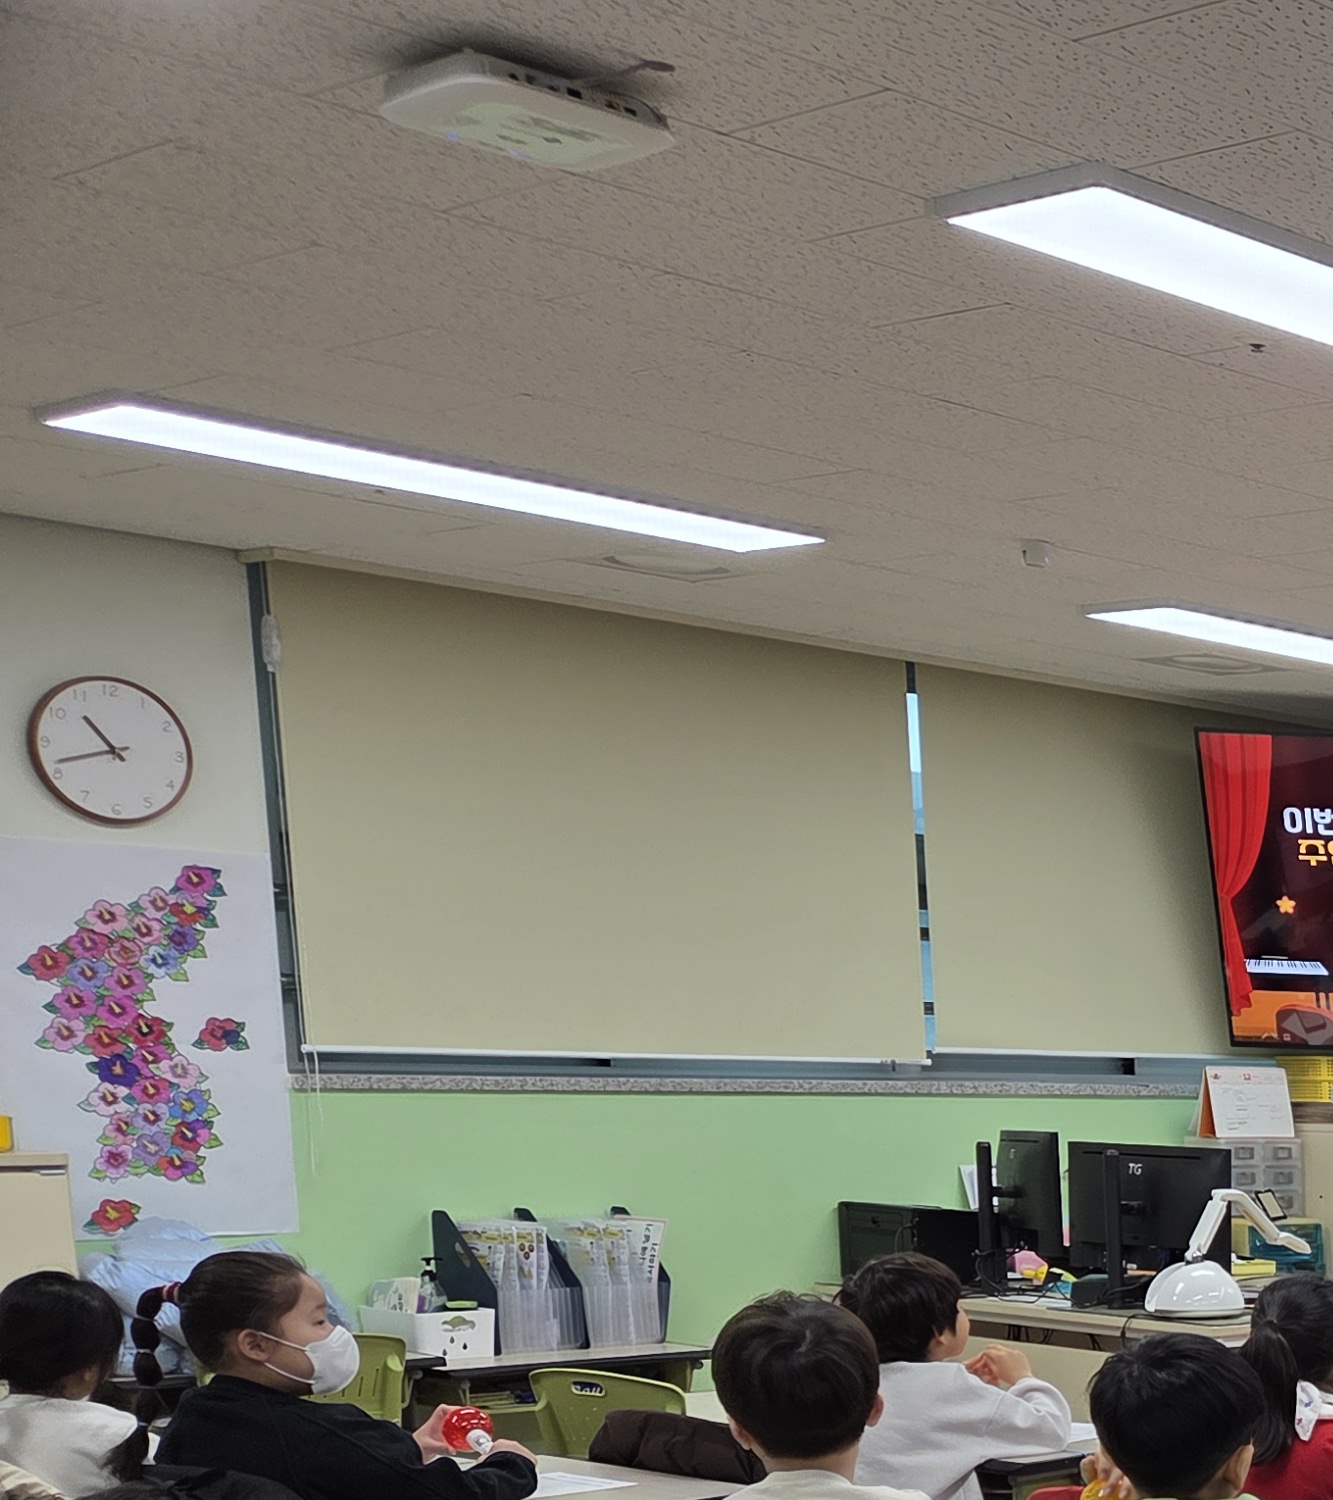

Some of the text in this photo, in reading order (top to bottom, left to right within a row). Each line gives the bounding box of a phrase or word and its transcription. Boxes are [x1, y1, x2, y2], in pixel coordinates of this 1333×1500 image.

[102, 684, 119, 698] 12
[49, 706, 67, 721] 10
[162, 721, 172, 733] 2
[40, 736, 50, 748] 9
[174, 751, 184, 764] 3
[53, 767, 63, 780] 8
[165, 779, 175, 790] 4
[111, 803, 122, 816] 6
[1128, 1162, 1142, 1176] TG
